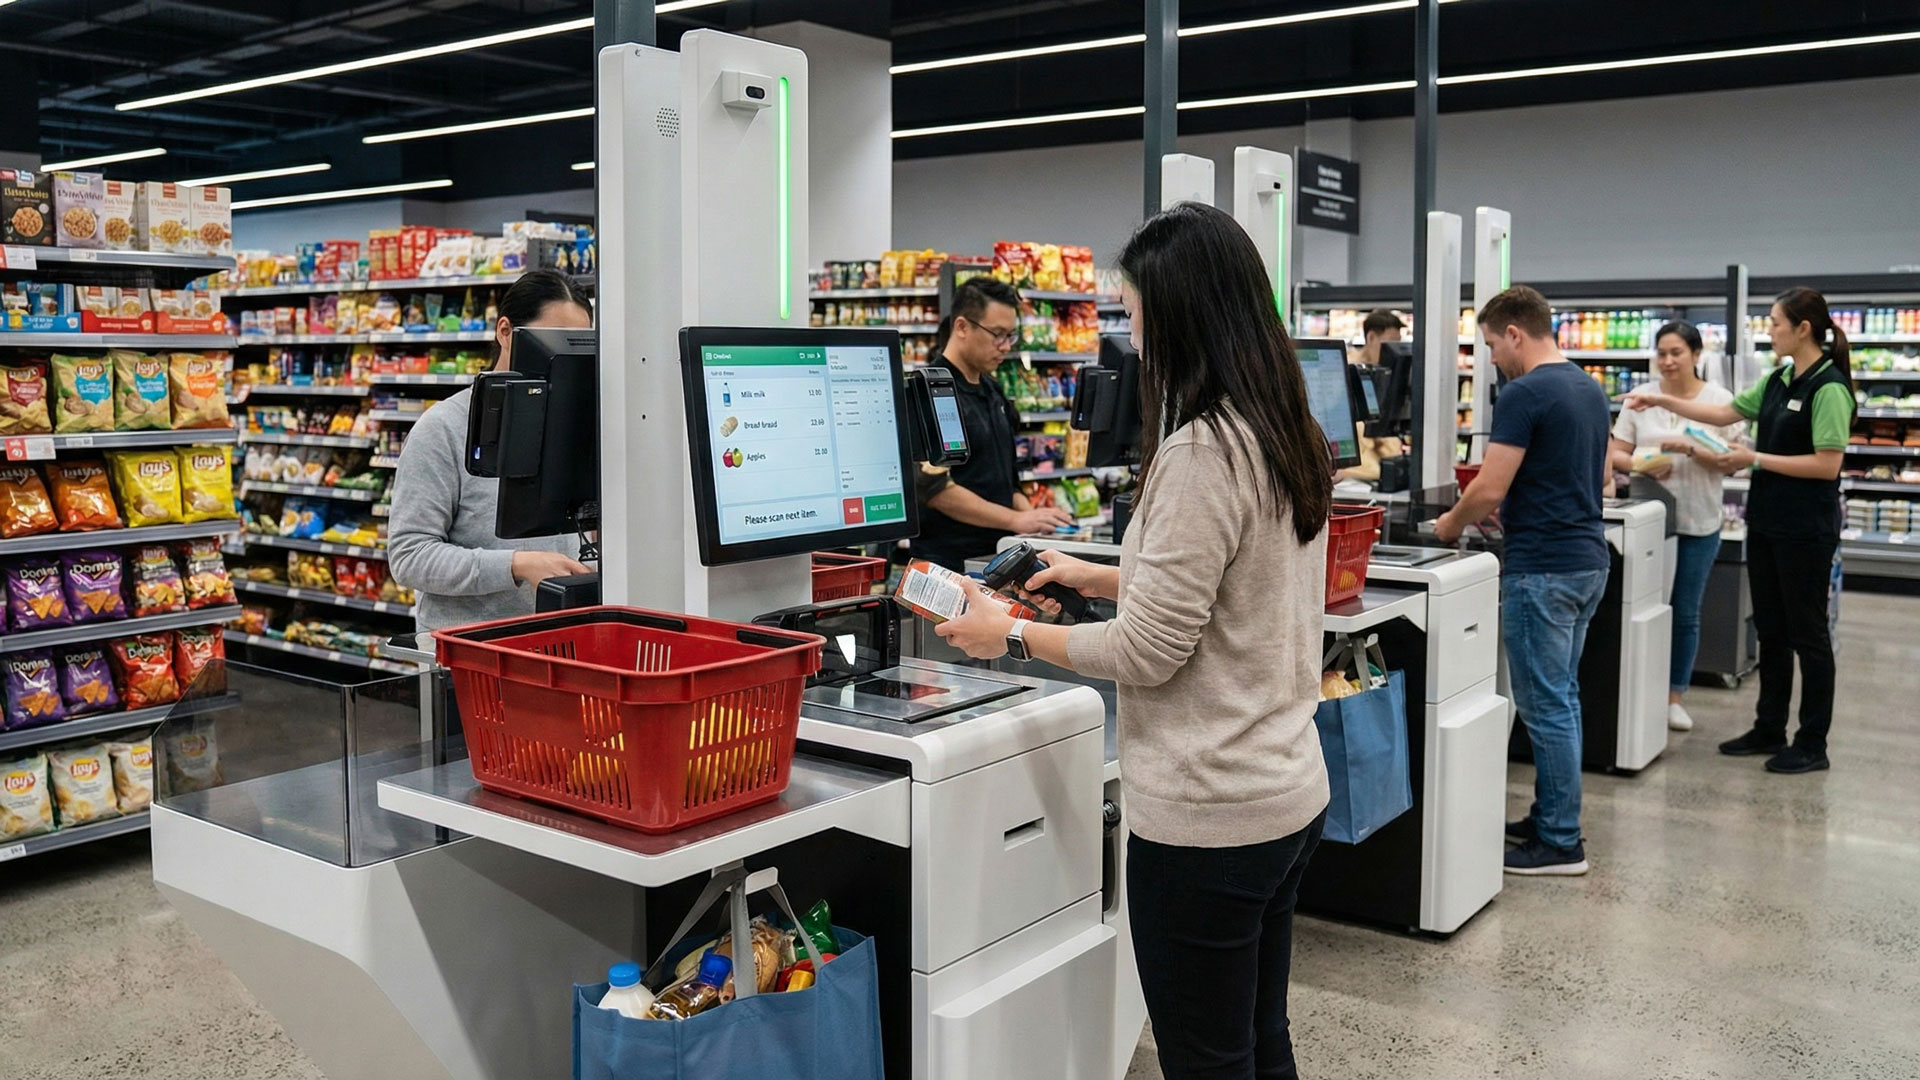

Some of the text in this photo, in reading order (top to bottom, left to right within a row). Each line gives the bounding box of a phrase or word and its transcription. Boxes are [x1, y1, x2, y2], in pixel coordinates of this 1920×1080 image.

[754, 390, 766, 398] milk
[744, 508, 818, 526] Please scan next item.
